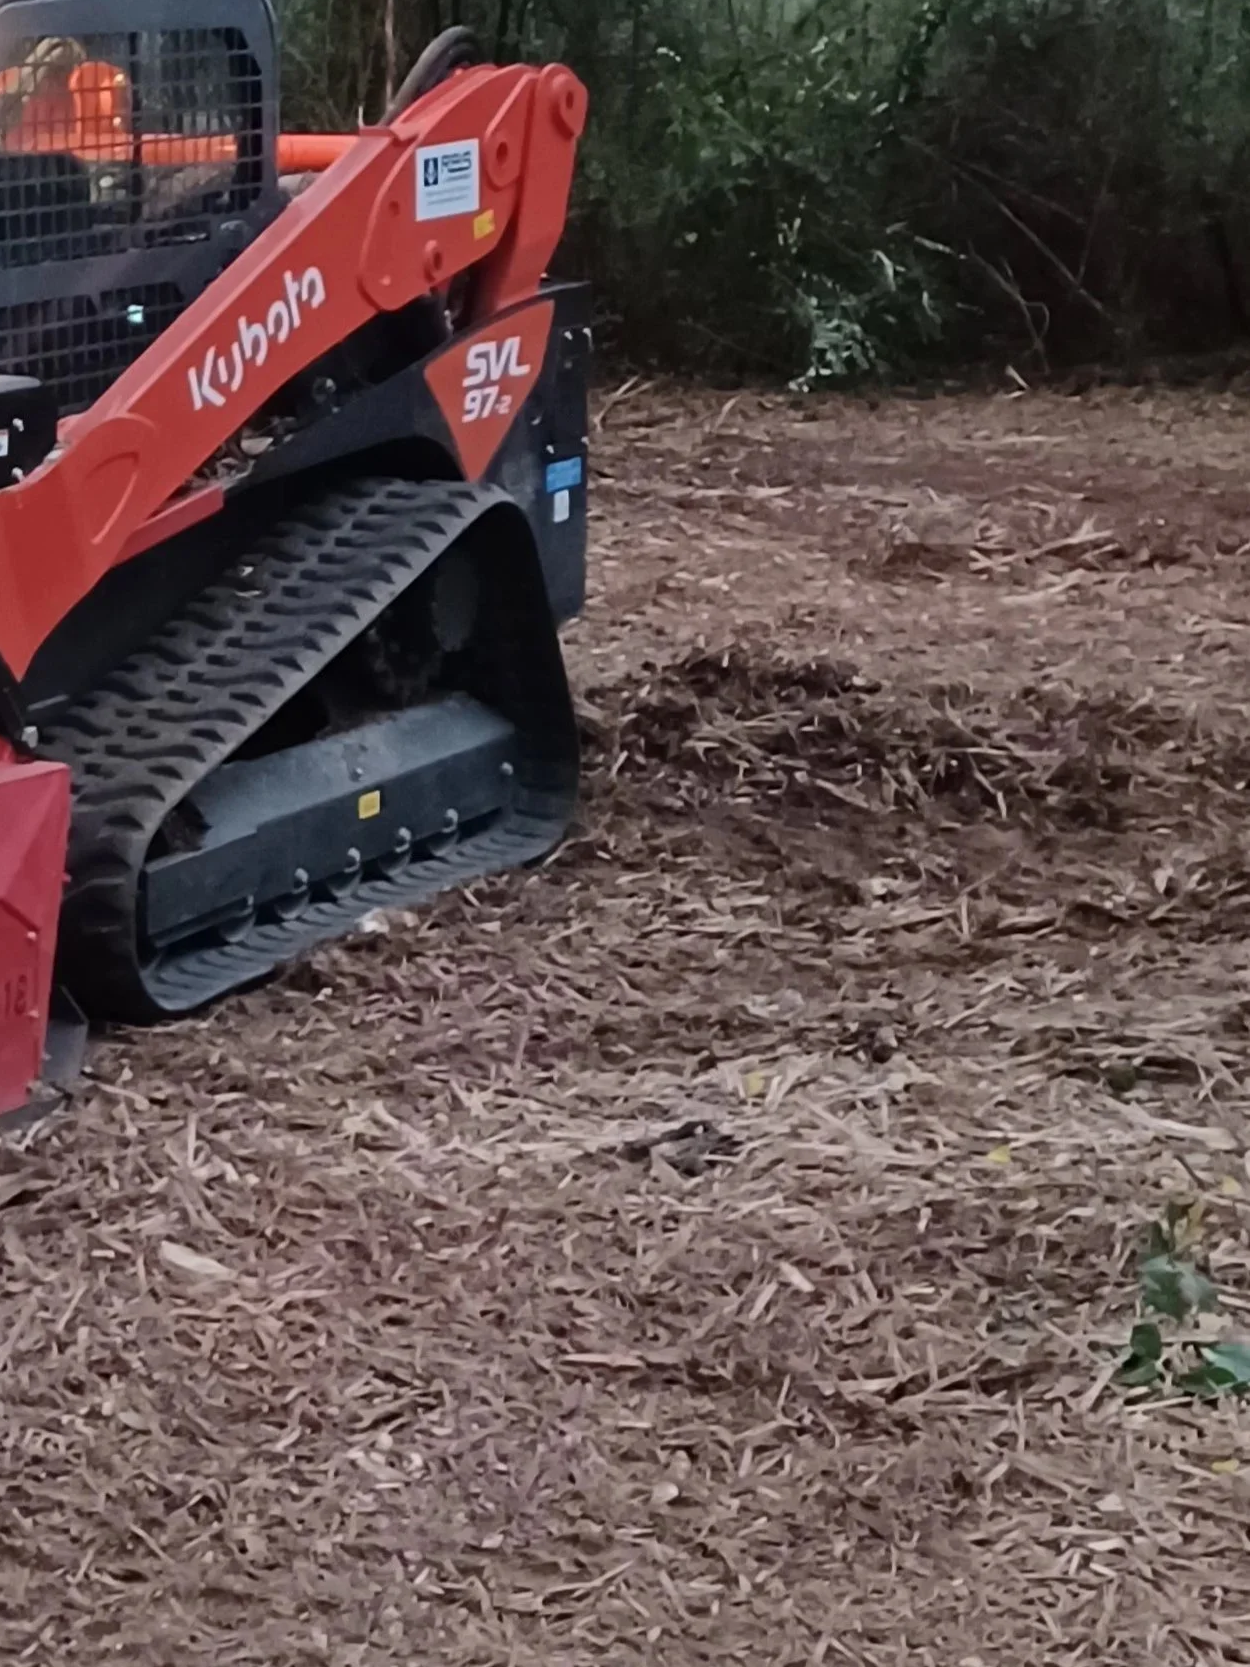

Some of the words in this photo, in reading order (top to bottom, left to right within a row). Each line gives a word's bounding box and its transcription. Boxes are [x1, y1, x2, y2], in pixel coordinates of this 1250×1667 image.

[187, 266, 326, 411] Kubota
[462, 336, 530, 387] SVL
[462, 385, 513, 423] 97-2
